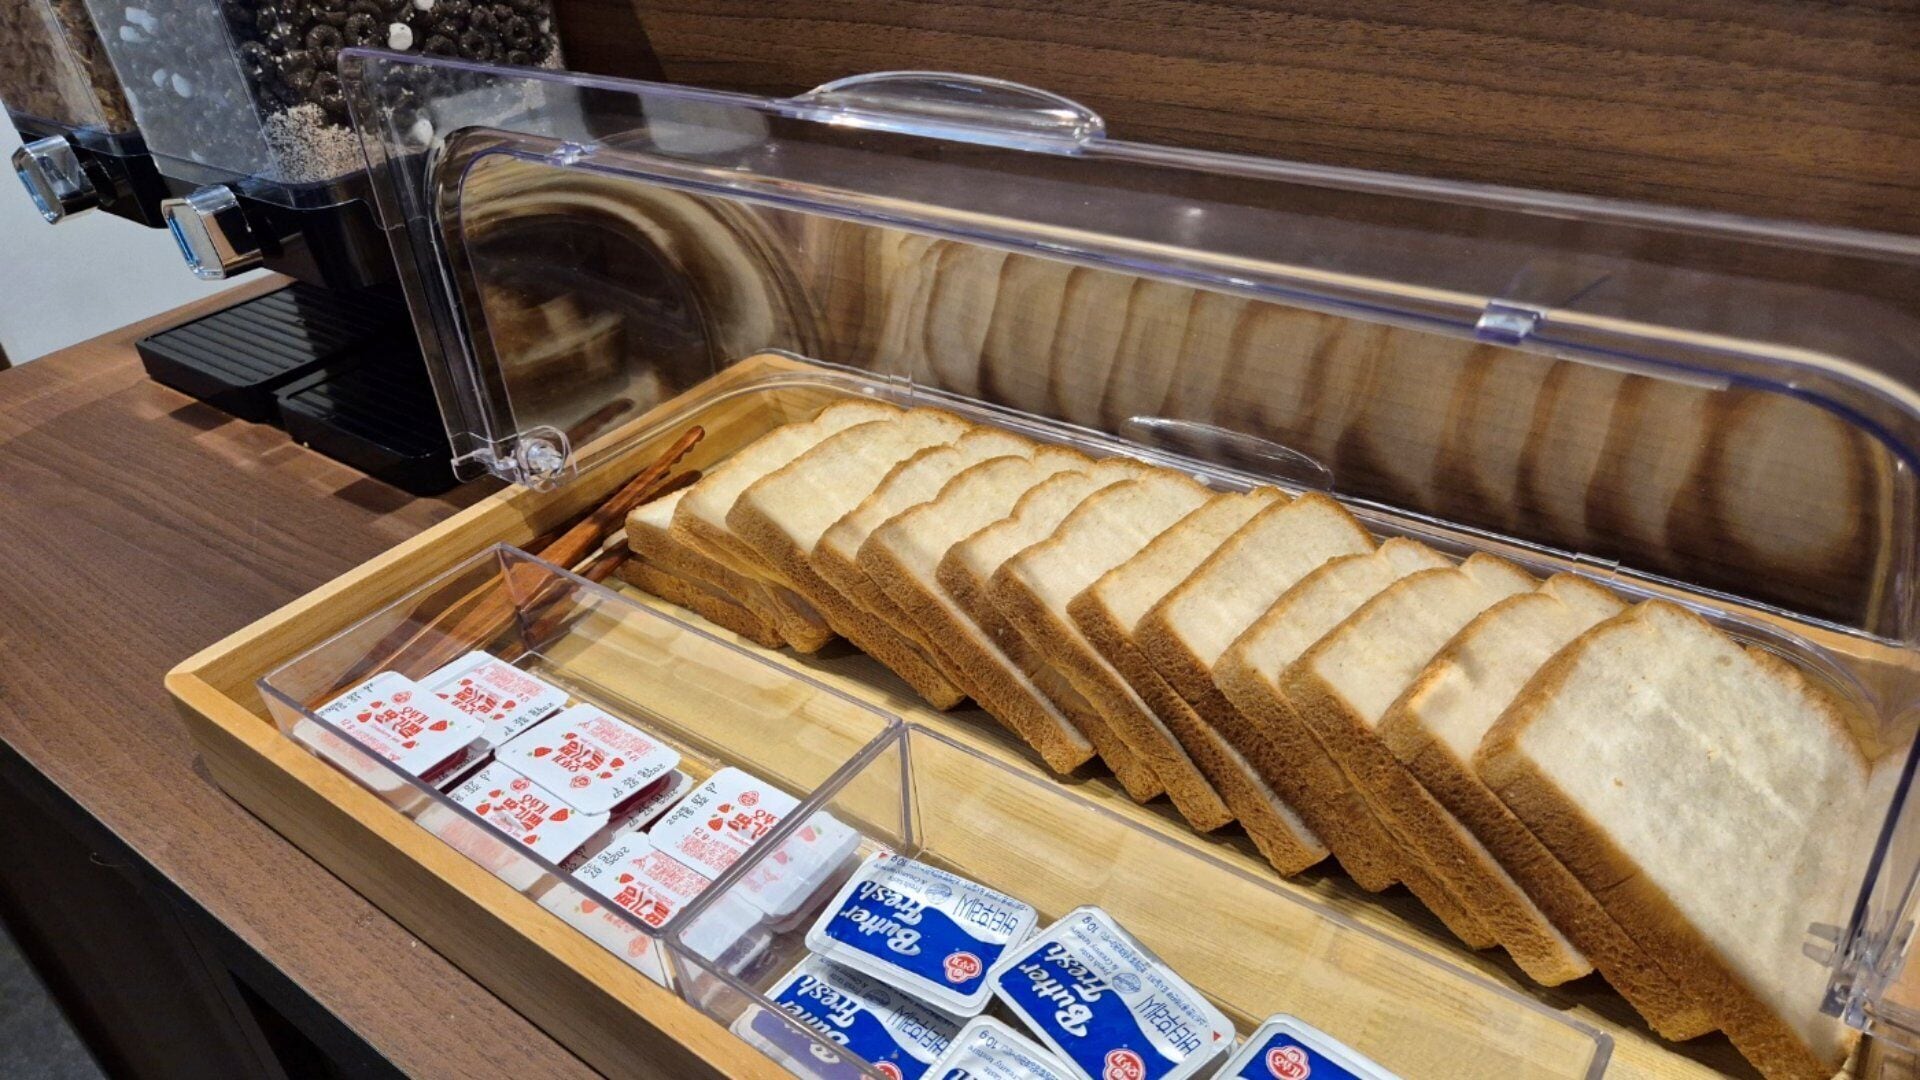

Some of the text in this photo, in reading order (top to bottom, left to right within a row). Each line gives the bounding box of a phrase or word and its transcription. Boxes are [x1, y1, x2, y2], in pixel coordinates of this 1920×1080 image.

[727, 813, 769, 839] 딸기
[859, 880, 923, 926] Fresh
[952, 895, 1019, 936] 버터후레시
[839, 905, 922, 957] Butter
[1044, 944, 1101, 1002] Fresh
[797, 974, 856, 1028] Fresh
[1019, 963, 1093, 1037] Butter
[1134, 994, 1201, 1056] 버터후레시
[887, 1005, 950, 1056] 버터후레시
